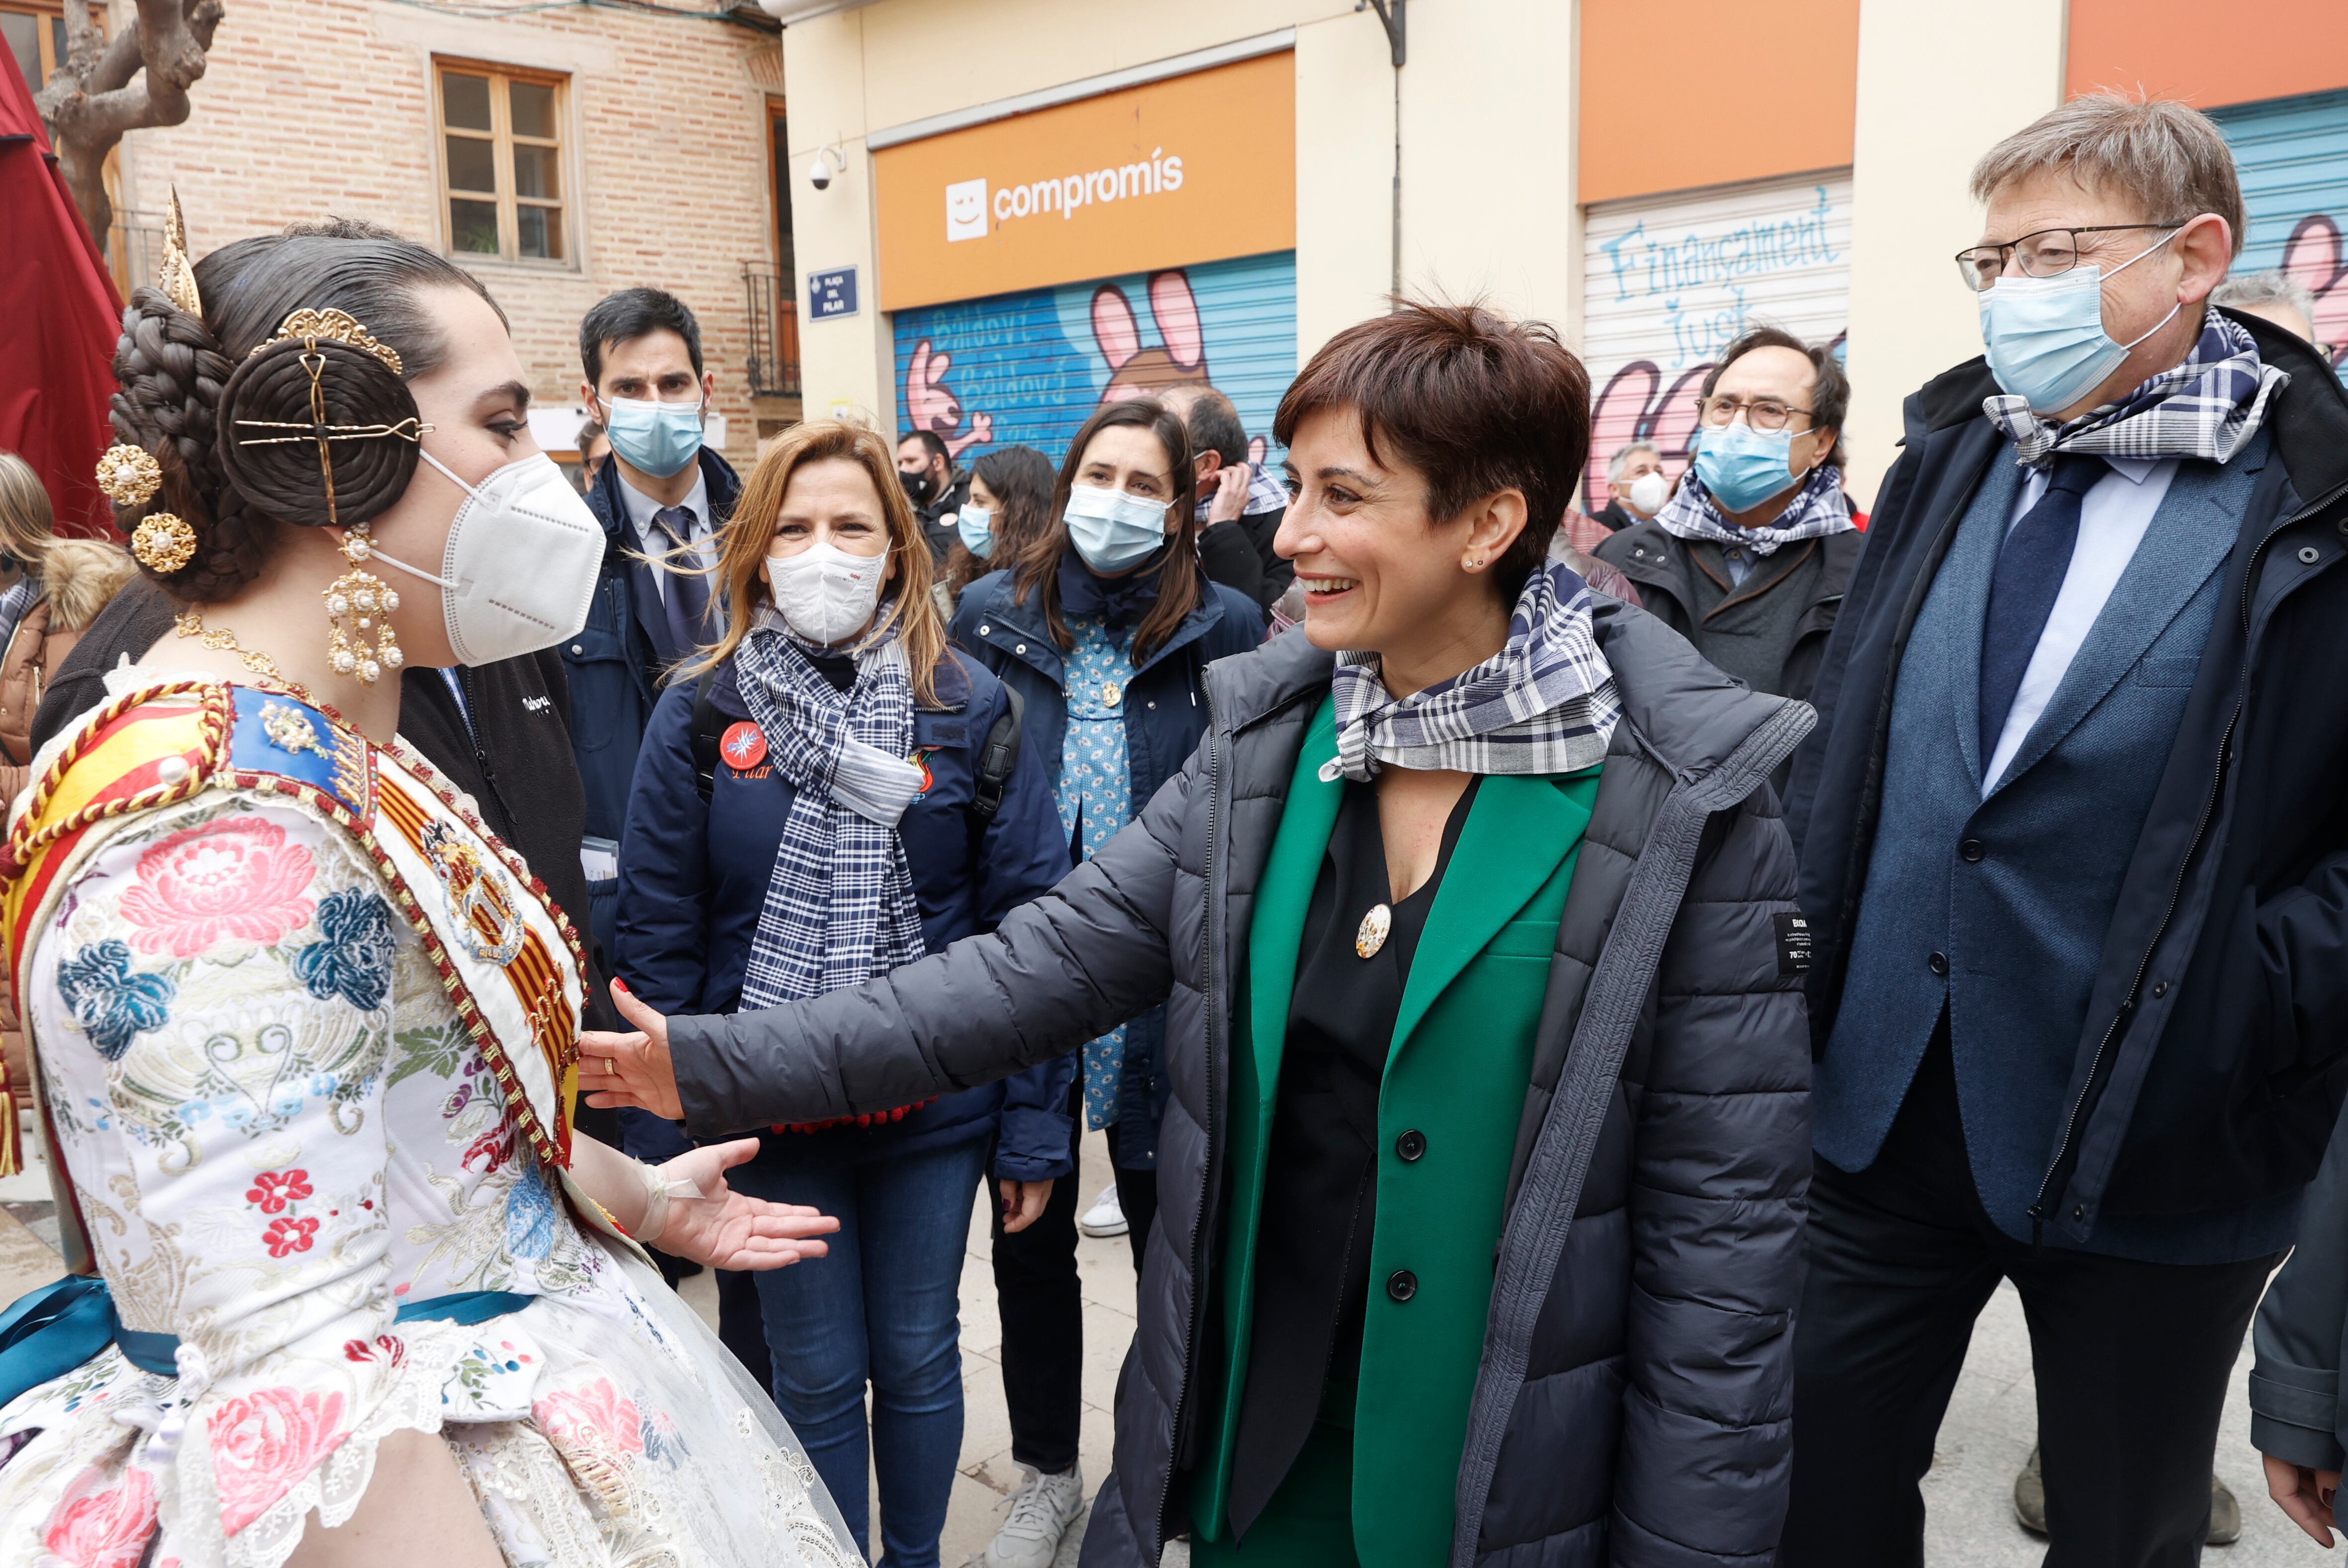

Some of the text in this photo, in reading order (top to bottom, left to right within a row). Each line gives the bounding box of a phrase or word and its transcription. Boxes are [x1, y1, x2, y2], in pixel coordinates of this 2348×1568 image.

[994, 146, 1183, 220] compromís
[1599, 185, 1839, 302] Finançament
[823, 299, 844, 313] PILAR
